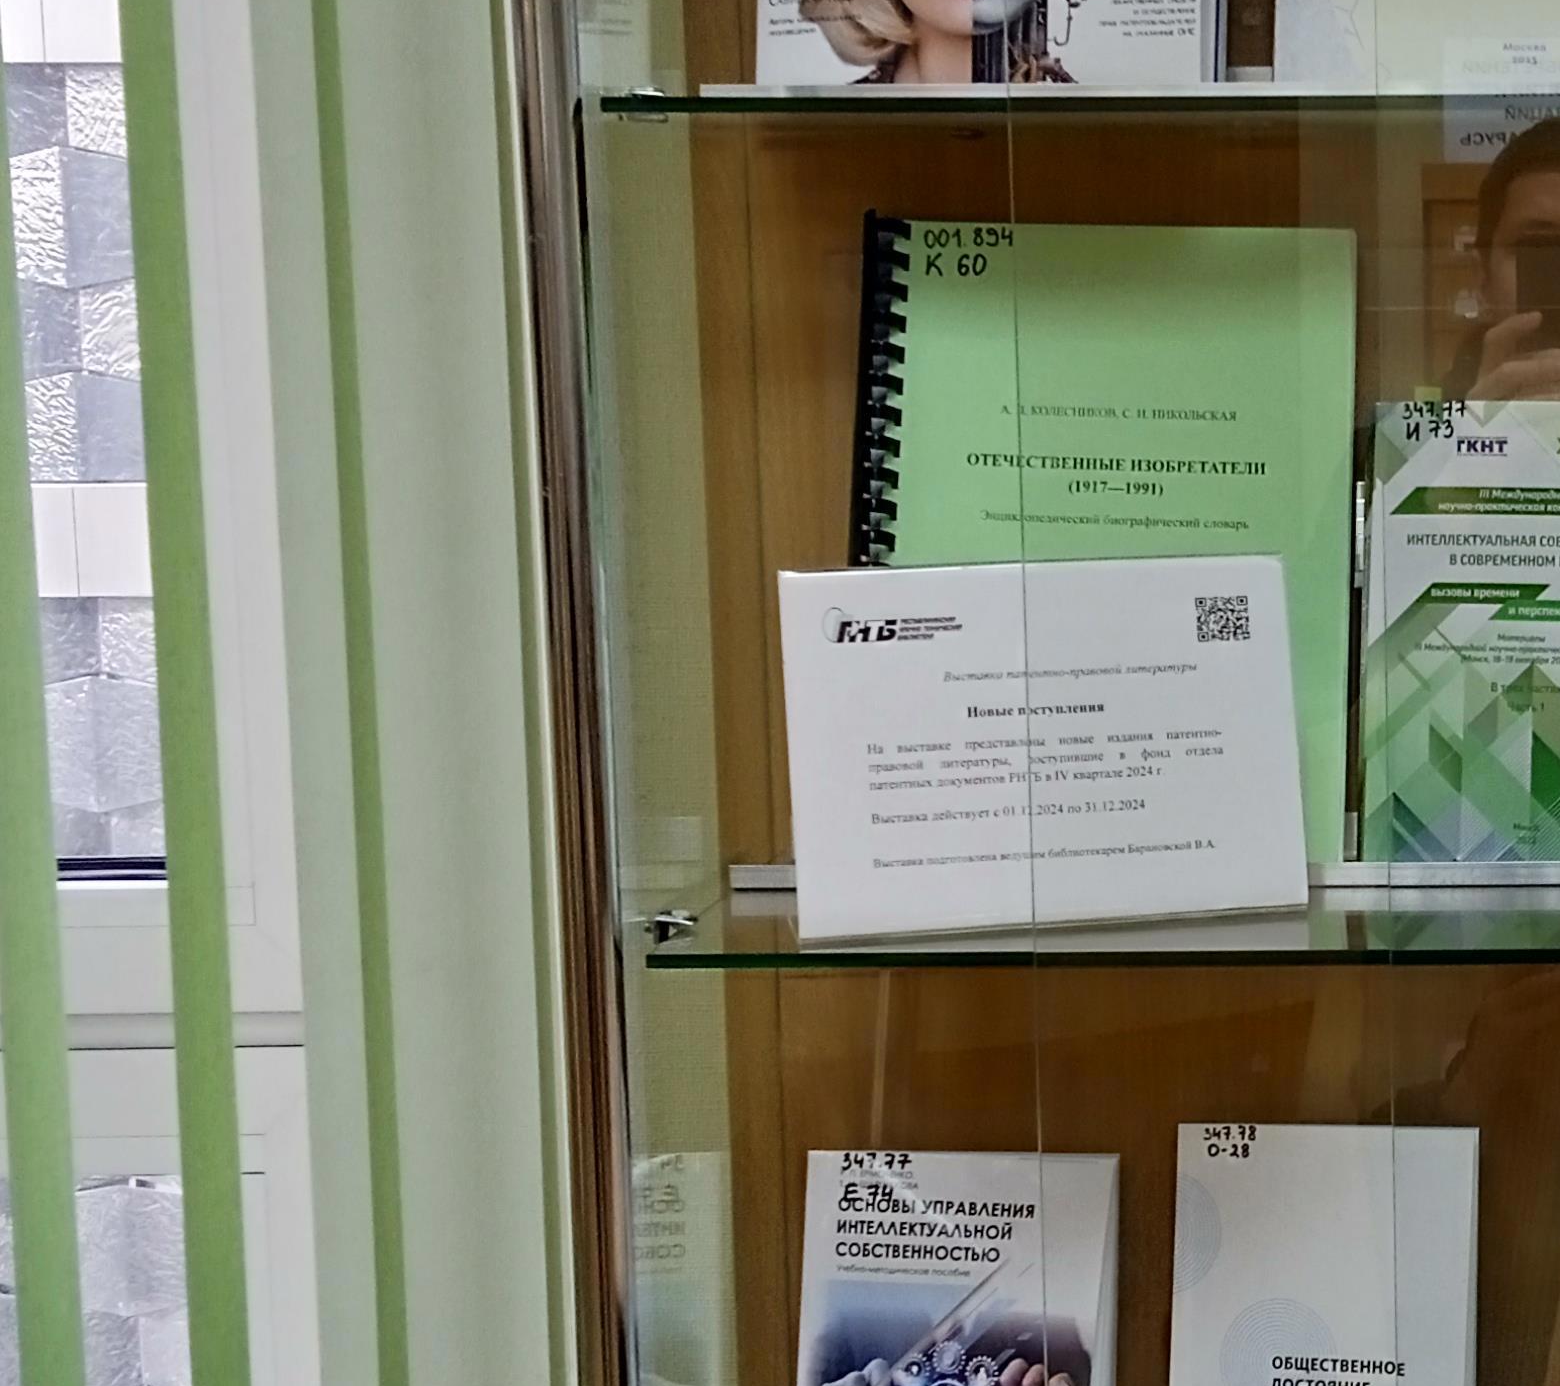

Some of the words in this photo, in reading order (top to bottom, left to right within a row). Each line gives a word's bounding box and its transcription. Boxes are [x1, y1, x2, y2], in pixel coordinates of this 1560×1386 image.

[924, 227, 1014, 249] 001.894
[925, 254, 943, 277] К
[956, 253, 987, 277] 60
[1406, 422, 1419, 441] И
[1429, 419, 1454, 439] 73
[1457, 439, 1507, 454] ГКНТ
[967, 452, 1126, 473] ОТЕЧЕСТВЕННЫЕ
[1130, 459, 1266, 476] ИЗОБРЕТАТЕЛИ
[1407, 534, 1536, 547] ИНТЕЛЛЕКТУАЛЬНАЯ
[1450, 554, 1457, 565] В
[1459, 554, 1555, 567] СОВРЕМЕННОМ
[1431, 588, 1471, 598] вызовы
[1473, 588, 1520, 599] времени
[1508, 608, 1515, 616] и
[967, 705, 1012, 718] Новые
[867, 743, 884, 756] На
[898, 741, 951, 752] выставке
[1058, 734, 1095, 746] новые
[1108, 731, 1153, 743] издания
[1204, 1127, 1256, 1141] 347.78
[838, 1199, 915, 1213] ОСНОВЫ
[922, 1200, 1035, 1219] УПРАВЛЕНИЯ
[836, 1220, 1012, 1240] ИНТЕЛЛЕКТУАЛЬНОЙ
[836, 1243, 1000, 1262] СОБСТВЕННОСТЬЮ
[1272, 1356, 1405, 1376] ОБЩЕСТВЕННОЕ
